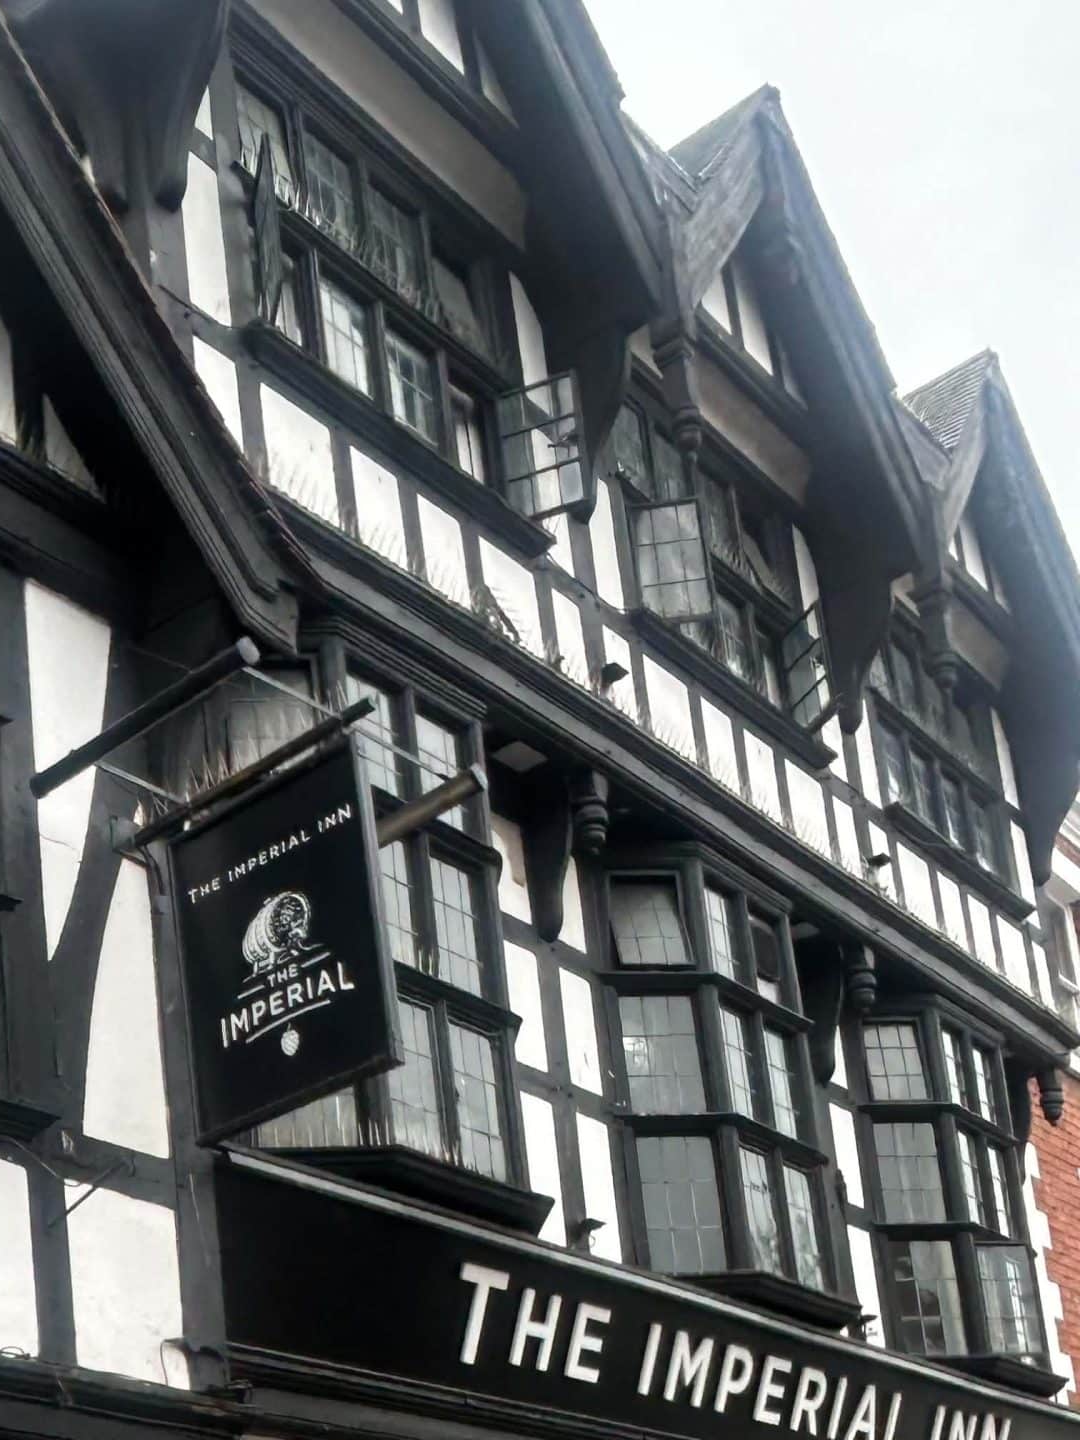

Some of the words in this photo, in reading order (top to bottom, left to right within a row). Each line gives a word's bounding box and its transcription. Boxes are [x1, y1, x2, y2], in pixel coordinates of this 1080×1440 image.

[188, 876, 222, 904] THE
[228, 829, 311, 883] IMPERIAL
[317, 803, 353, 833] INN
[220, 961, 356, 1049] IMPERIAL
[266, 963, 299, 989] THE
[459, 1261, 613, 1385] THE
